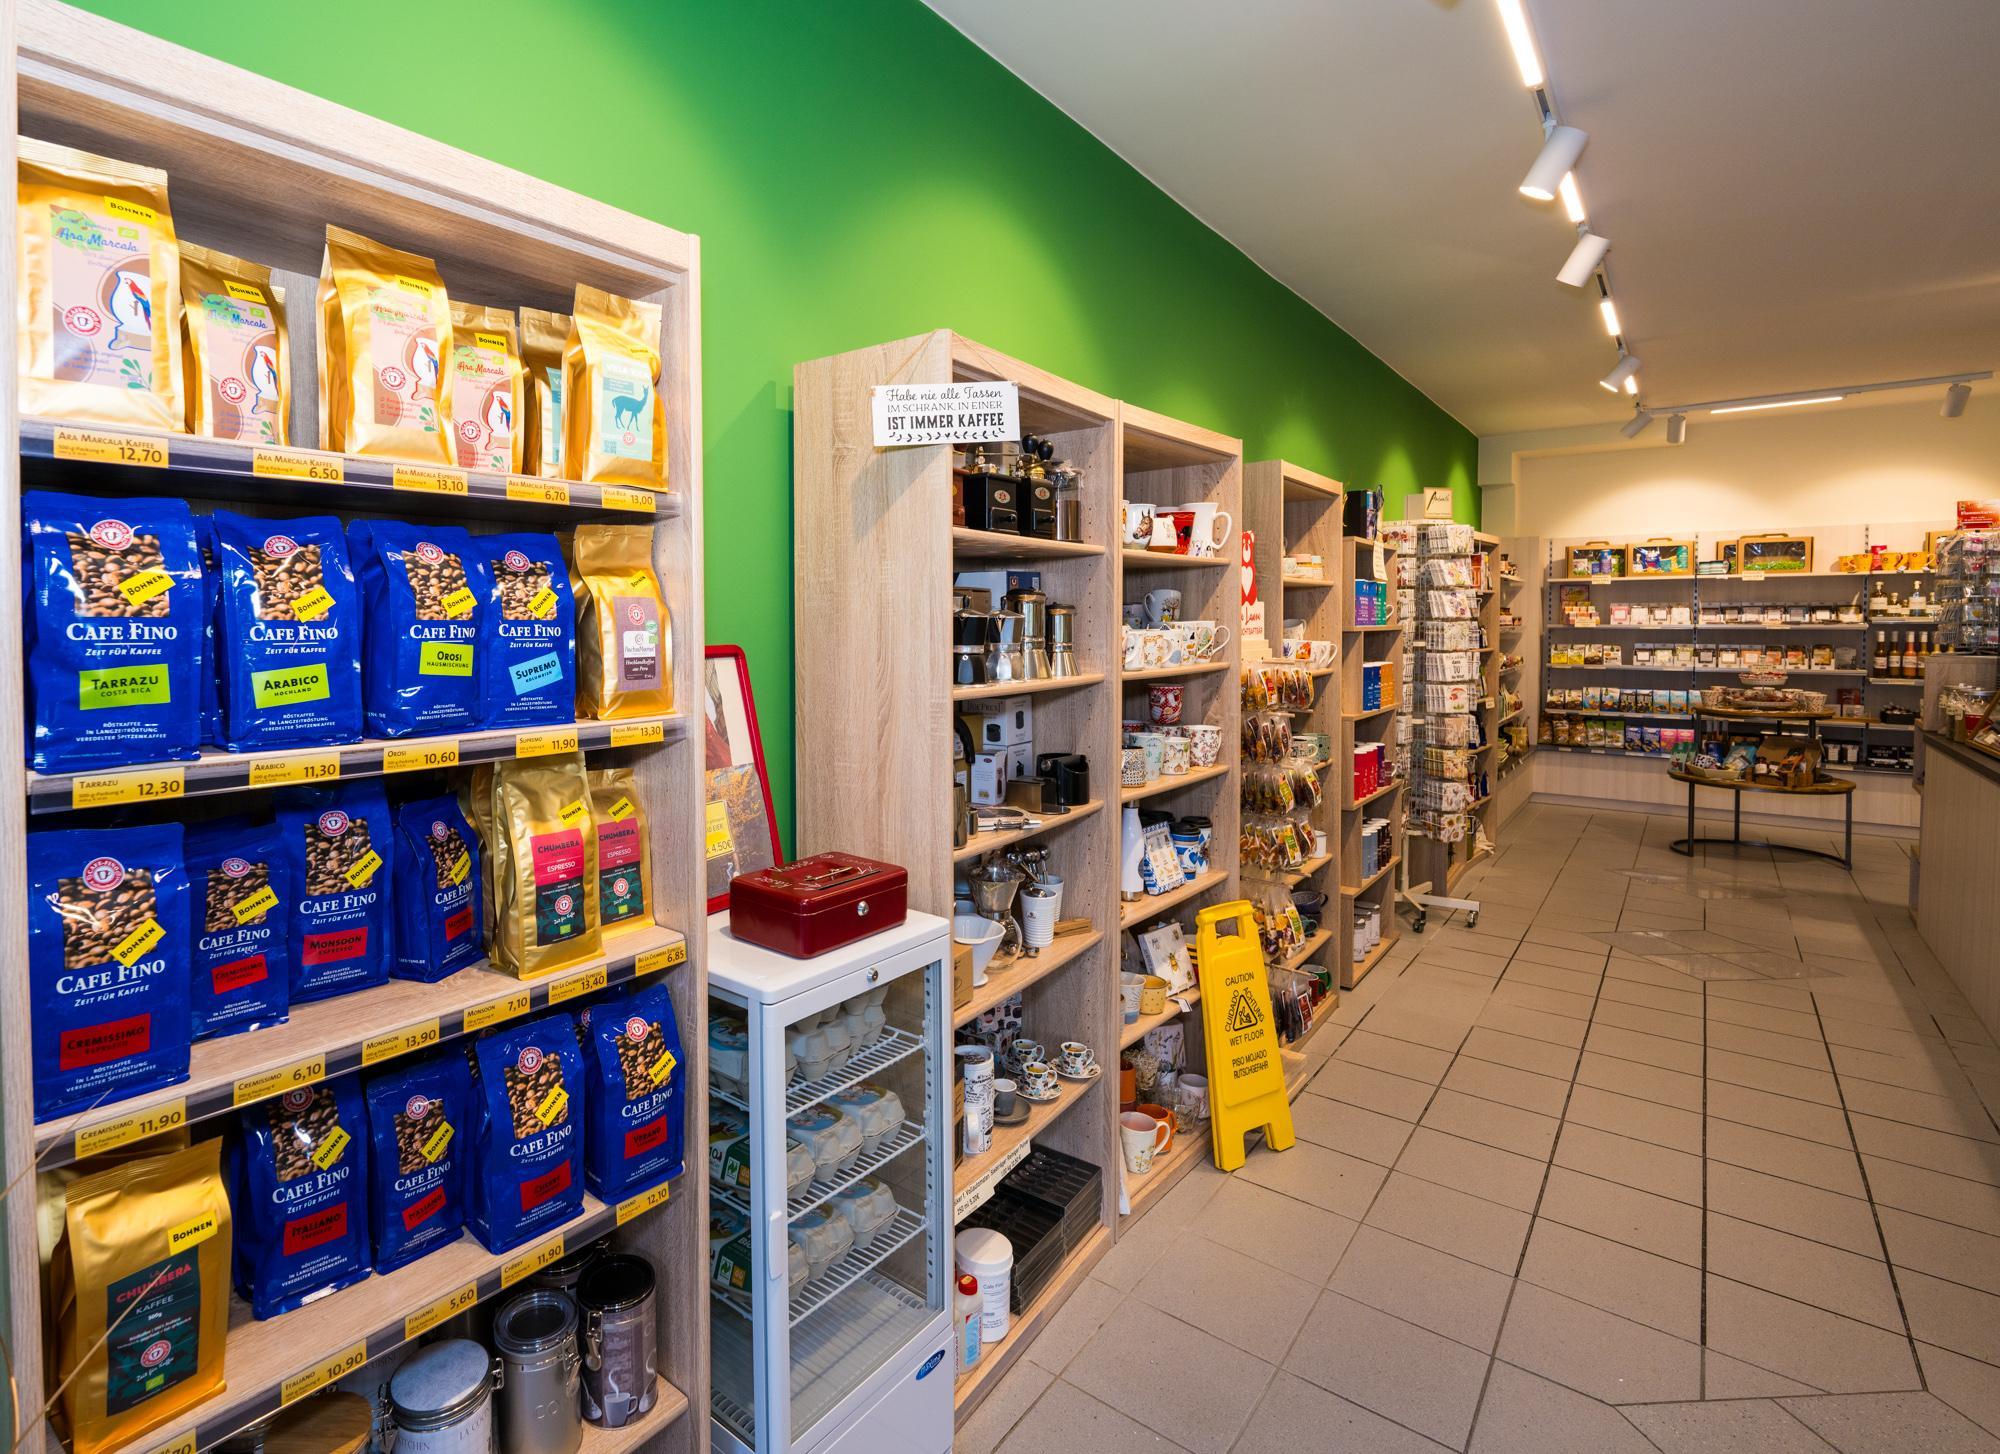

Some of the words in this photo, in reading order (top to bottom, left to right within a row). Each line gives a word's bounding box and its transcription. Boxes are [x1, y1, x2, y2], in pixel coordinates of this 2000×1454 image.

[109, 202, 152, 219] BOHNEN
[87, 234, 138, 253] Marcala
[229, 285, 260, 297] BOHNEN
[399, 279, 429, 292] BOHNEN
[479, 336, 505, 346] BOHNEN
[886, 389, 917, 402] Habe
[921, 391, 936, 400] nie
[941, 388, 960, 400] alle
[964, 387, 1002, 399] Tassen
[888, 405, 900, 413] IM
[958, 402, 969, 410] IN
[972, 401, 1003, 410] EINER
[888, 417, 905, 430] IST
[910, 415, 953, 429] IMMER
[958, 413, 1004, 427] KAFFEE
[59, 432, 77, 441] ARA
[81, 435, 122, 446] MARCALA
[126, 440, 154, 449] KAFFEE
[119, 447, 161, 462] 12,70
[257, 453, 272, 462] ARA
[273, 455, 307, 467] MARCALA
[309, 459, 332, 469] KAFFEE
[437, 479, 464, 492] 13,10
[631, 494, 653, 505] 13,00
[127, 574, 164, 597] BOHNEN
[297, 595, 327, 614] BOHNEN
[447, 594, 471, 610] BOHNEN
[534, 592, 551, 612] BOHNEN
[66, 623, 123, 641] CAFE
[129, 623, 177, 640] FINO
[250, 625, 294, 641] CAFE
[299, 625, 338, 639] FINO
[410, 625, 446, 639] CAFE
[450, 625, 475, 638] FINO
[499, 624, 530, 638] CAFE
[534, 624, 561, 637] FINO
[85, 648, 108, 656] ZEIT
[109, 647, 127, 656] FÜR
[437, 650, 462, 661] OROSI
[426, 660, 469, 669] HAUSMISCHUNG
[516, 659, 557, 681] SUPREMO
[91, 675, 159, 690] TARRAZU
[263, 675, 319, 690] ARABICO
[101, 688, 128, 697] COSTA
[131, 686, 151, 694] RICA
[274, 687, 312, 697] HOCHLAND
[640, 726, 660, 737] 13,30
[552, 738, 575, 750] 11,90
[255, 763, 285, 771] ARABICO
[424, 752, 455, 765] 10,60
[304, 764, 336, 778] 11,30
[80, 780, 118, 789] TARRAZU
[138, 780, 179, 796] 12,30
[562, 806, 581, 821] BOHNEN
[612, 802, 629, 816] BOHNEN
[599, 830, 635, 841] CHUMBERA
[538, 840, 579, 853] CHUMBERA
[608, 848, 631, 858] ESPRESSO
[350, 856, 376, 881] BOHNEN
[454, 858, 469, 879] BOHNEN
[547, 862, 575, 872] ESPRESSO
[435, 889, 457, 905] CAFE
[459, 882, 473, 896] FINO
[238, 894, 272, 917] BOHNEN
[300, 901, 339, 914] CAFE
[344, 893, 376, 908] FINO
[343, 912, 366, 920] KAFFEE
[120, 927, 156, 959] BOHNEN
[199, 935, 234, 951] CAFE
[237, 928, 271, 944] FINO
[310, 935, 361, 949] MONSOON
[667, 950, 684, 963] 6,85
[56, 972, 112, 995] CAFE
[117, 959, 166, 983] FINO
[581, 976, 604, 991] 13,40
[1225, 972, 1255, 987] CAUTION
[74, 996, 95, 1008] ZEIT
[98, 992, 115, 1002] FÜR
[118, 984, 149, 998] KAFFEE
[508, 997, 528, 1011] 7,10
[467, 1005, 495, 1017] MONSOON
[1225, 989, 1240, 1032] CUIDADO
[1243, 987, 1265, 1023] ACHTUNG
[366, 1035, 399, 1050] MONSOON
[405, 1030, 436, 1048] 13,90
[1229, 1036, 1243, 1047] WET
[1244, 1029, 1264, 1043] FLOOR
[1232, 1058, 1244, 1068] PISO
[1245, 1049, 1267, 1064] MOJADO
[293, 1063, 321, 1081] 6,10
[653, 1057, 672, 1079] BOHNEN
[1233, 1061, 1269, 1079] RUTSCHGEFAHR
[238, 1073, 282, 1091] CREMISSIMO
[541, 1091, 562, 1119] BOHNEN
[622, 1101, 650, 1118] CAFE
[652, 1089, 673, 1108] FINO
[81, 1120, 134, 1139] CREMISSIMO
[140, 1112, 181, 1134] 11,90
[319, 1134, 343, 1163] BOHNEN
[427, 1127, 449, 1157] BOHNEN
[510, 1139, 543, 1158] CAFE
[547, 1125, 572, 1147] FINO
[395, 1176, 419, 1191] CAFE
[427, 1160, 450, 1180] FINO
[272, 1182, 313, 1204] CAFE
[317, 1166, 349, 1191] FINO
[287, 1206, 302, 1214] ZEIT
[304, 1200, 316, 1208] FÜR
[318, 1189, 340, 1201] KAFFEE
[647, 1188, 667, 1205] 12,10
[173, 1219, 212, 1243] BOHNEN
[537, 1245, 561, 1265] 11,90
[136, 1295, 173, 1315] KAFFEE
[450, 1288, 474, 1310] 5,60
[409, 1308, 434, 1324] ITALIANO
[327, 1352, 363, 1379] 10,90
[286, 1371, 315, 1390] ITALIANO
